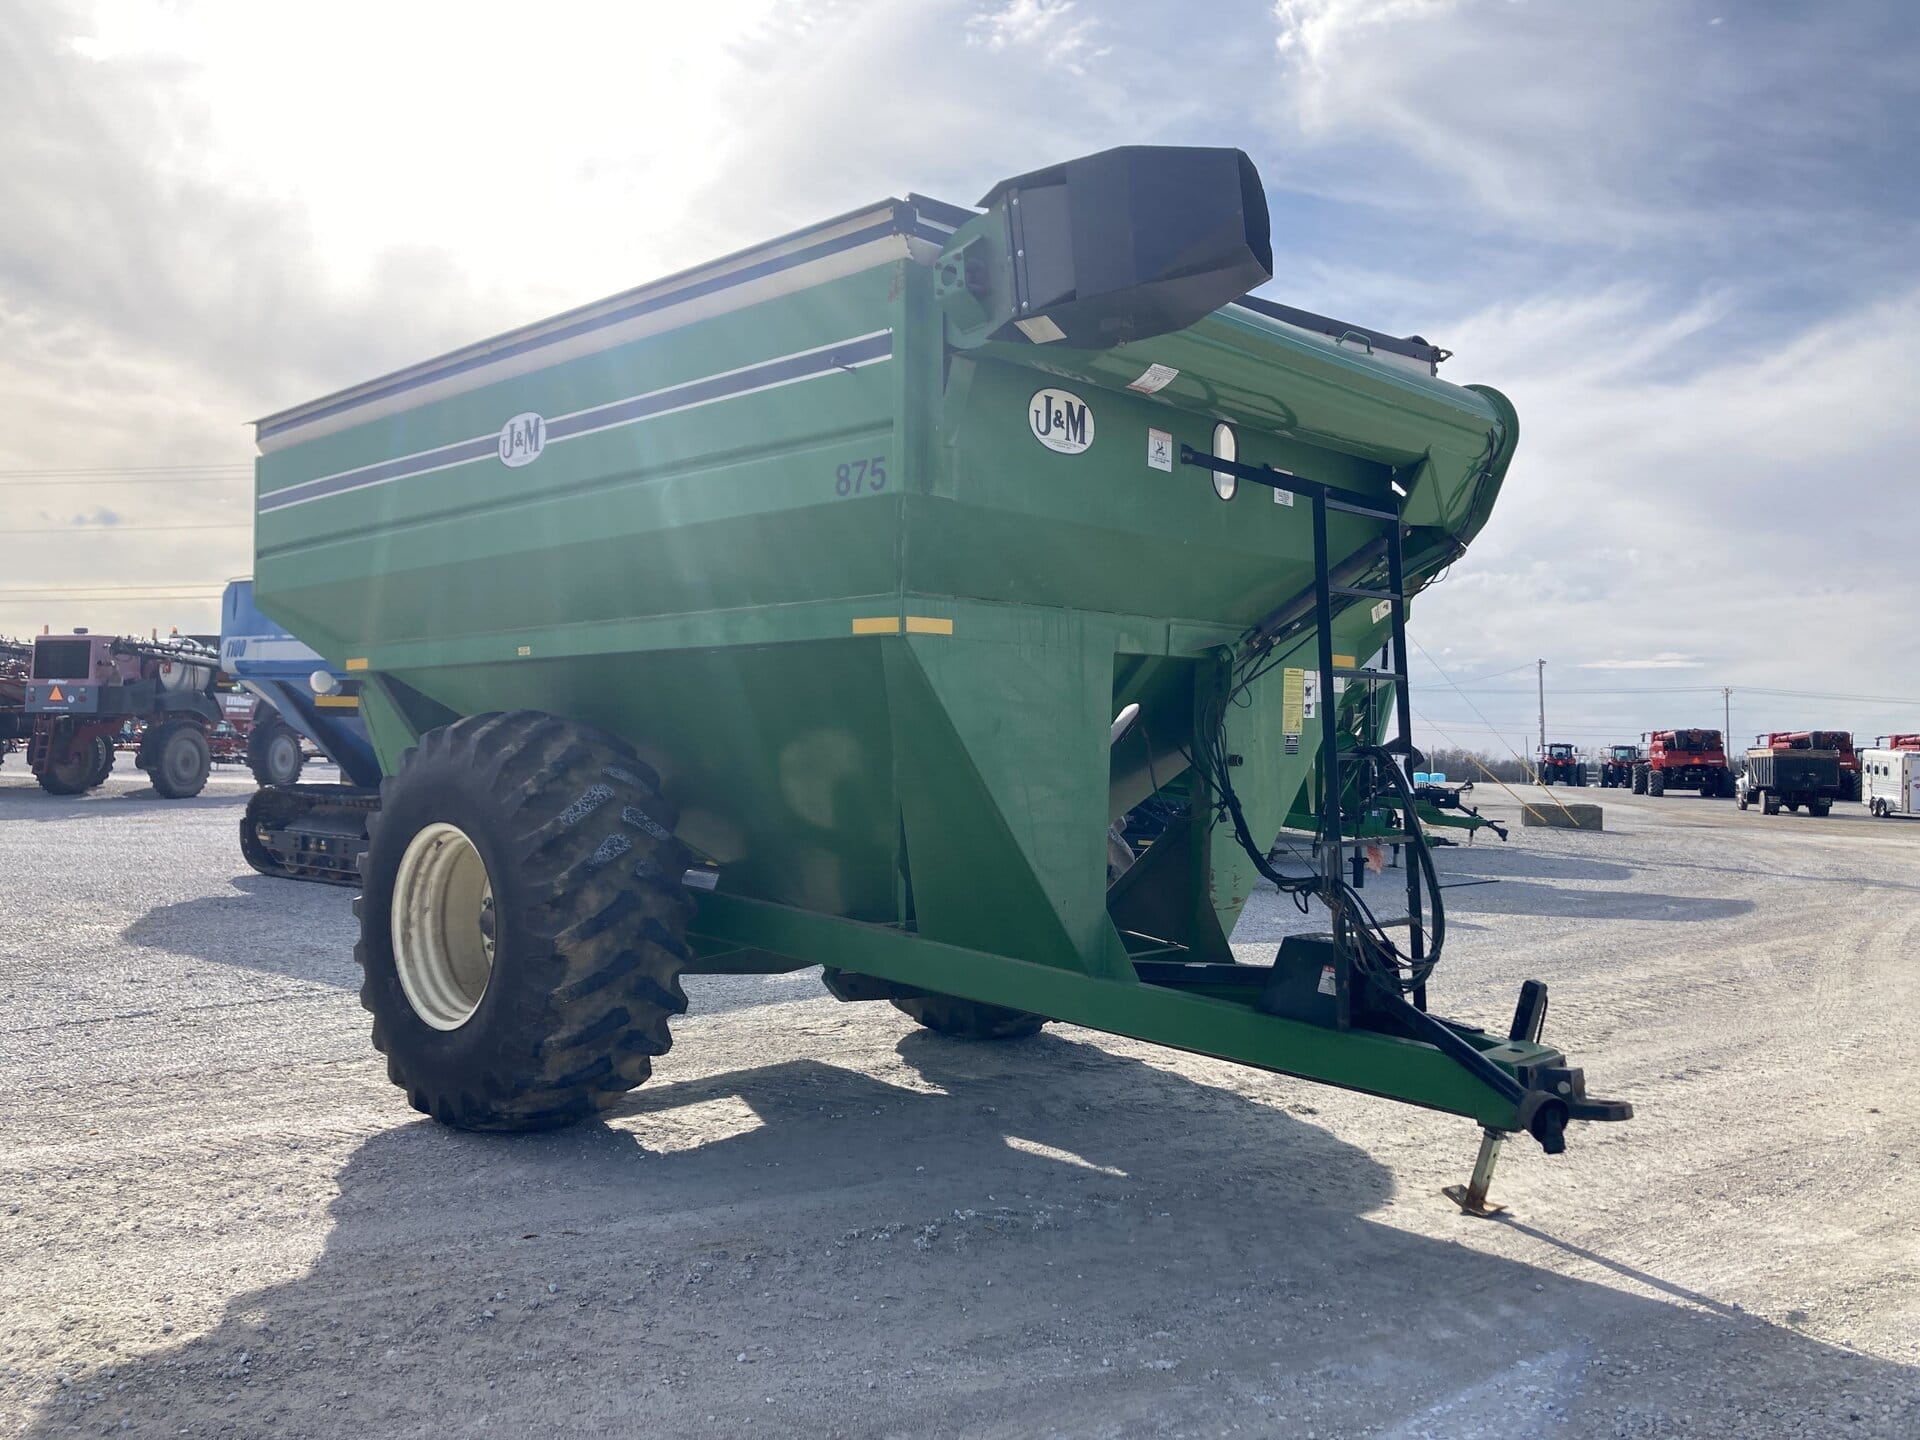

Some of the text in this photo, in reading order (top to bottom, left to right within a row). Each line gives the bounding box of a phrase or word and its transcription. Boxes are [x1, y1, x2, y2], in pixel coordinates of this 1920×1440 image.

[502, 416, 541, 459] J&M
[1034, 394, 1086, 445] J&M
[835, 455, 887, 497] 875
